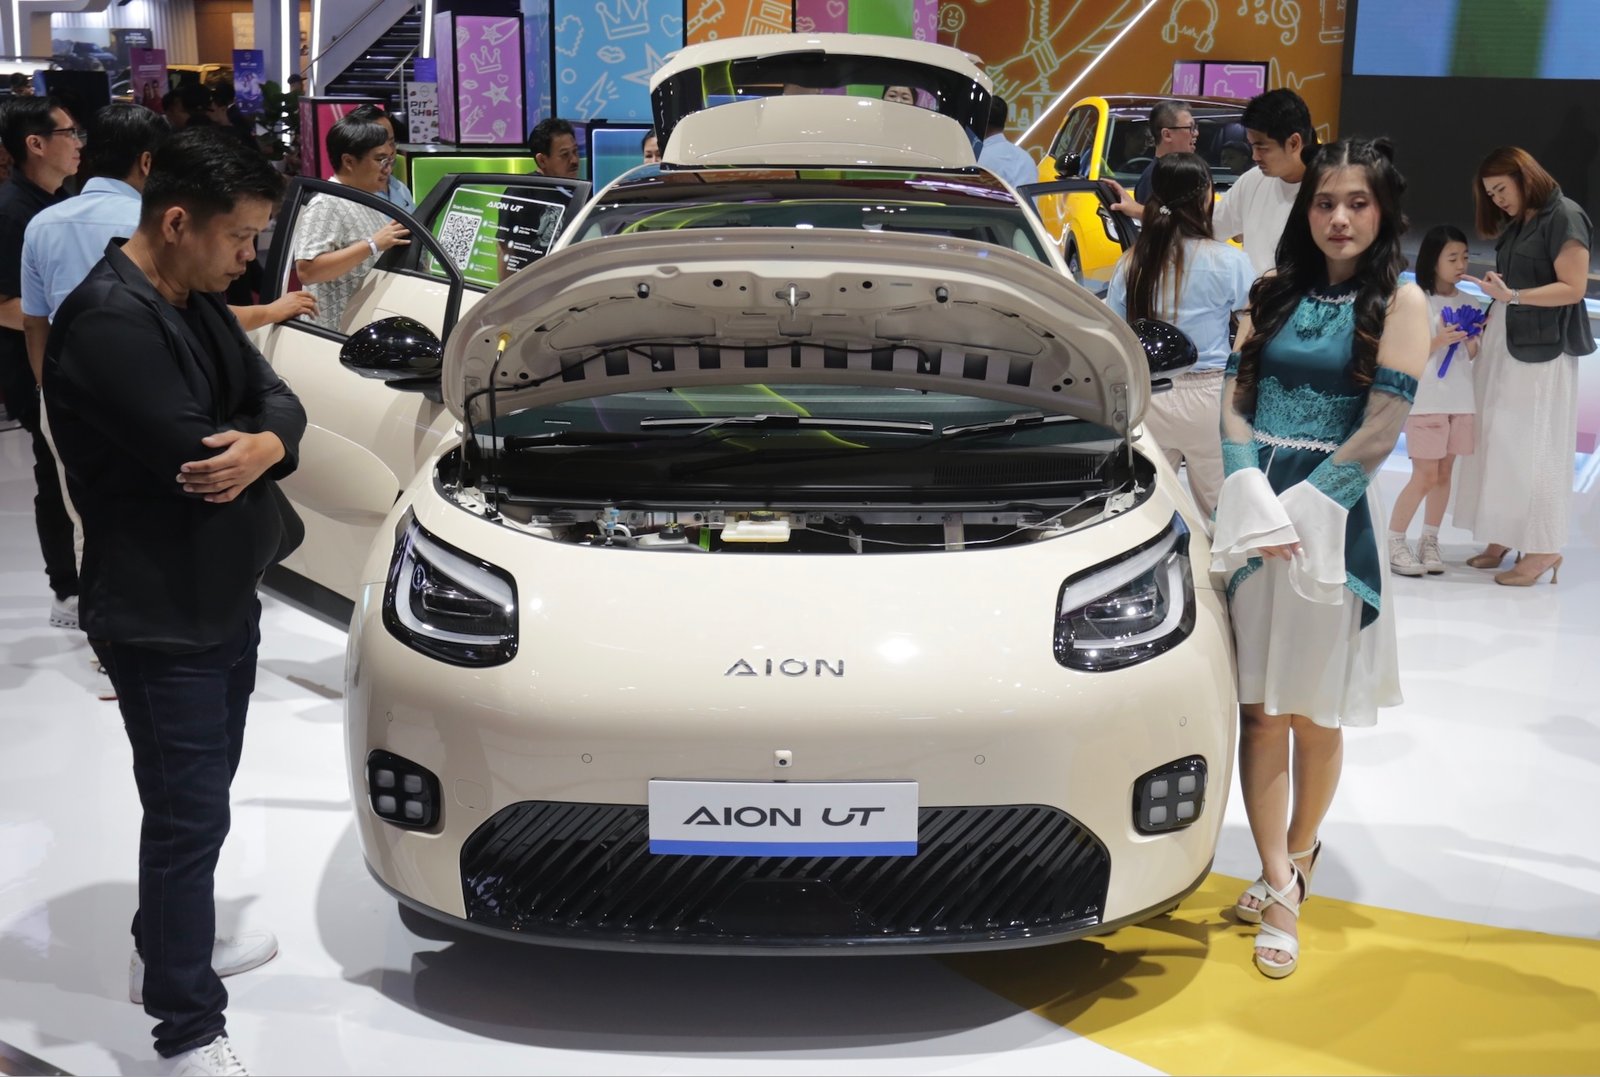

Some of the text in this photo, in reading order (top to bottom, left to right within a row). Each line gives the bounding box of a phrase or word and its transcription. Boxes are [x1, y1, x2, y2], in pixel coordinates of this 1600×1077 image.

[410, 100, 428, 108] PIT
[486, 200, 524, 213] AION UT
[724, 658, 845, 677] AION
[682, 805, 886, 827] AION UT
